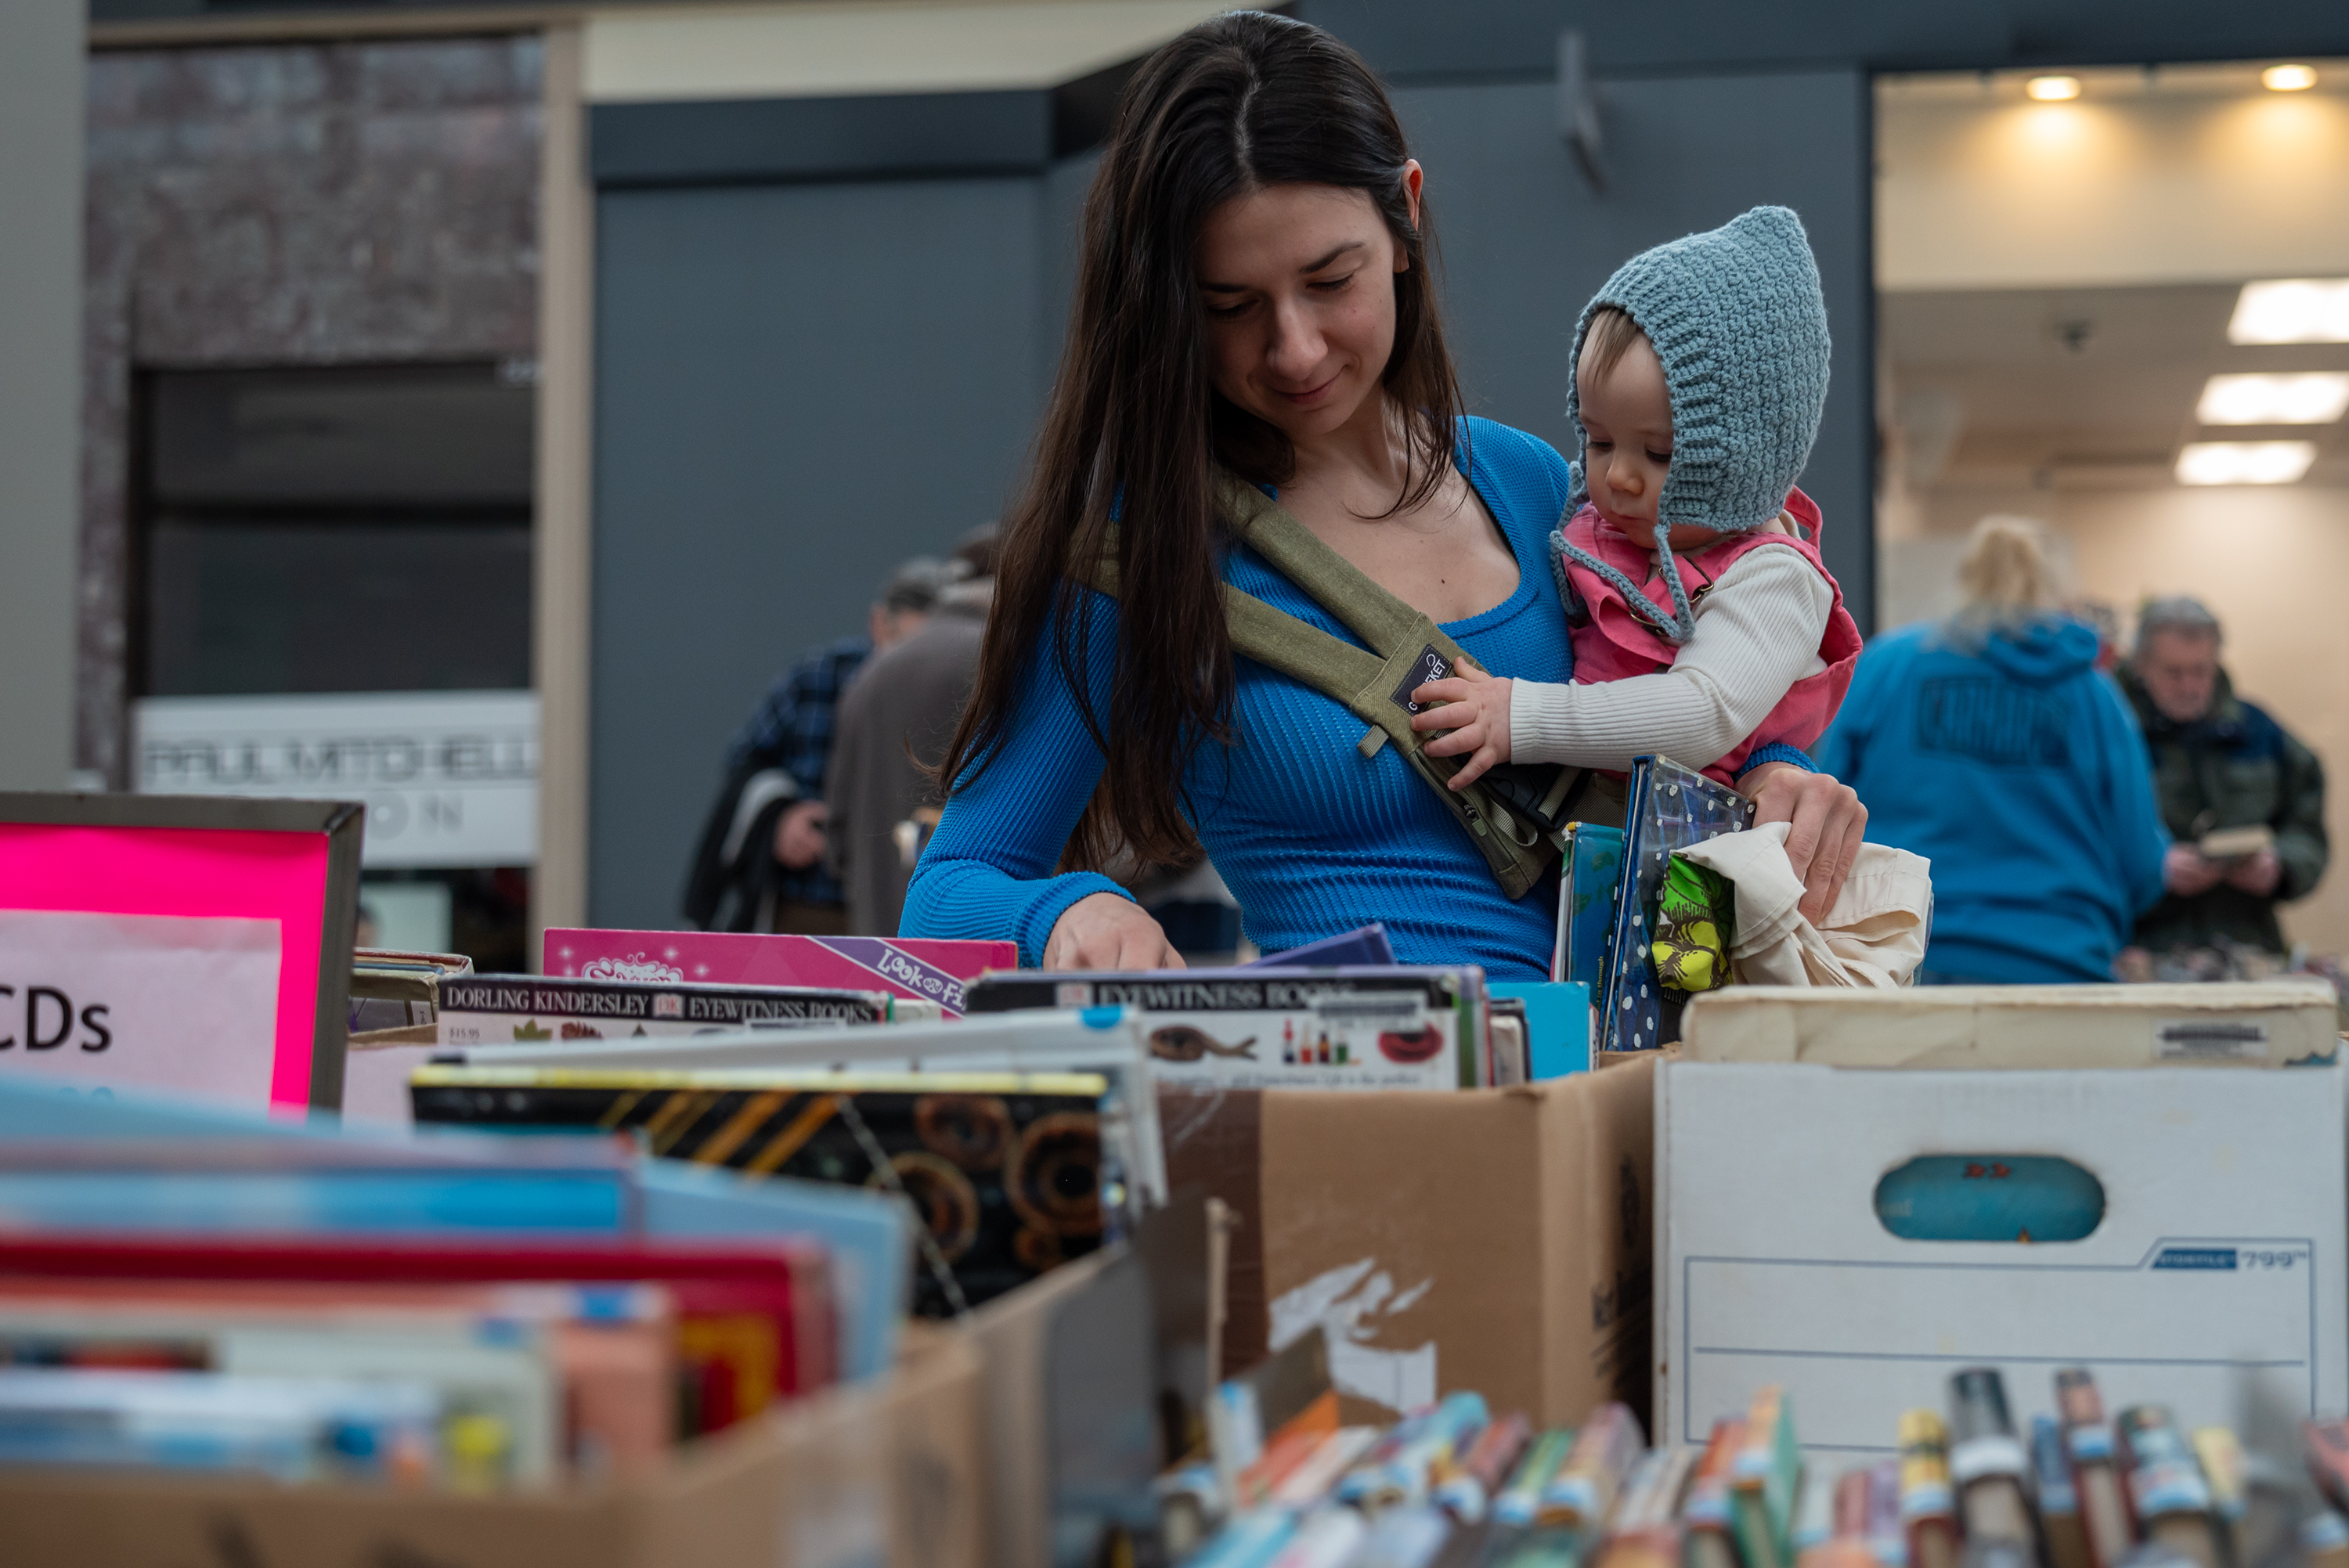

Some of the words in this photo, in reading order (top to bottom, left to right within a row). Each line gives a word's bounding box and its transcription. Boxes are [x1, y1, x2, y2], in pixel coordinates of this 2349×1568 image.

[1409, 659, 1446, 711] GEKET
[877, 948, 924, 988] Look
[942, 982, 968, 1011] Fi
[1098, 982, 1263, 1009] EYEWITNESS
[446, 986, 529, 1011] DORLING
[534, 990, 649, 1016] KINDERSLEY
[688, 997, 806, 1021] EYEWITNESS
[809, 1000, 872, 1024] BOOKS
